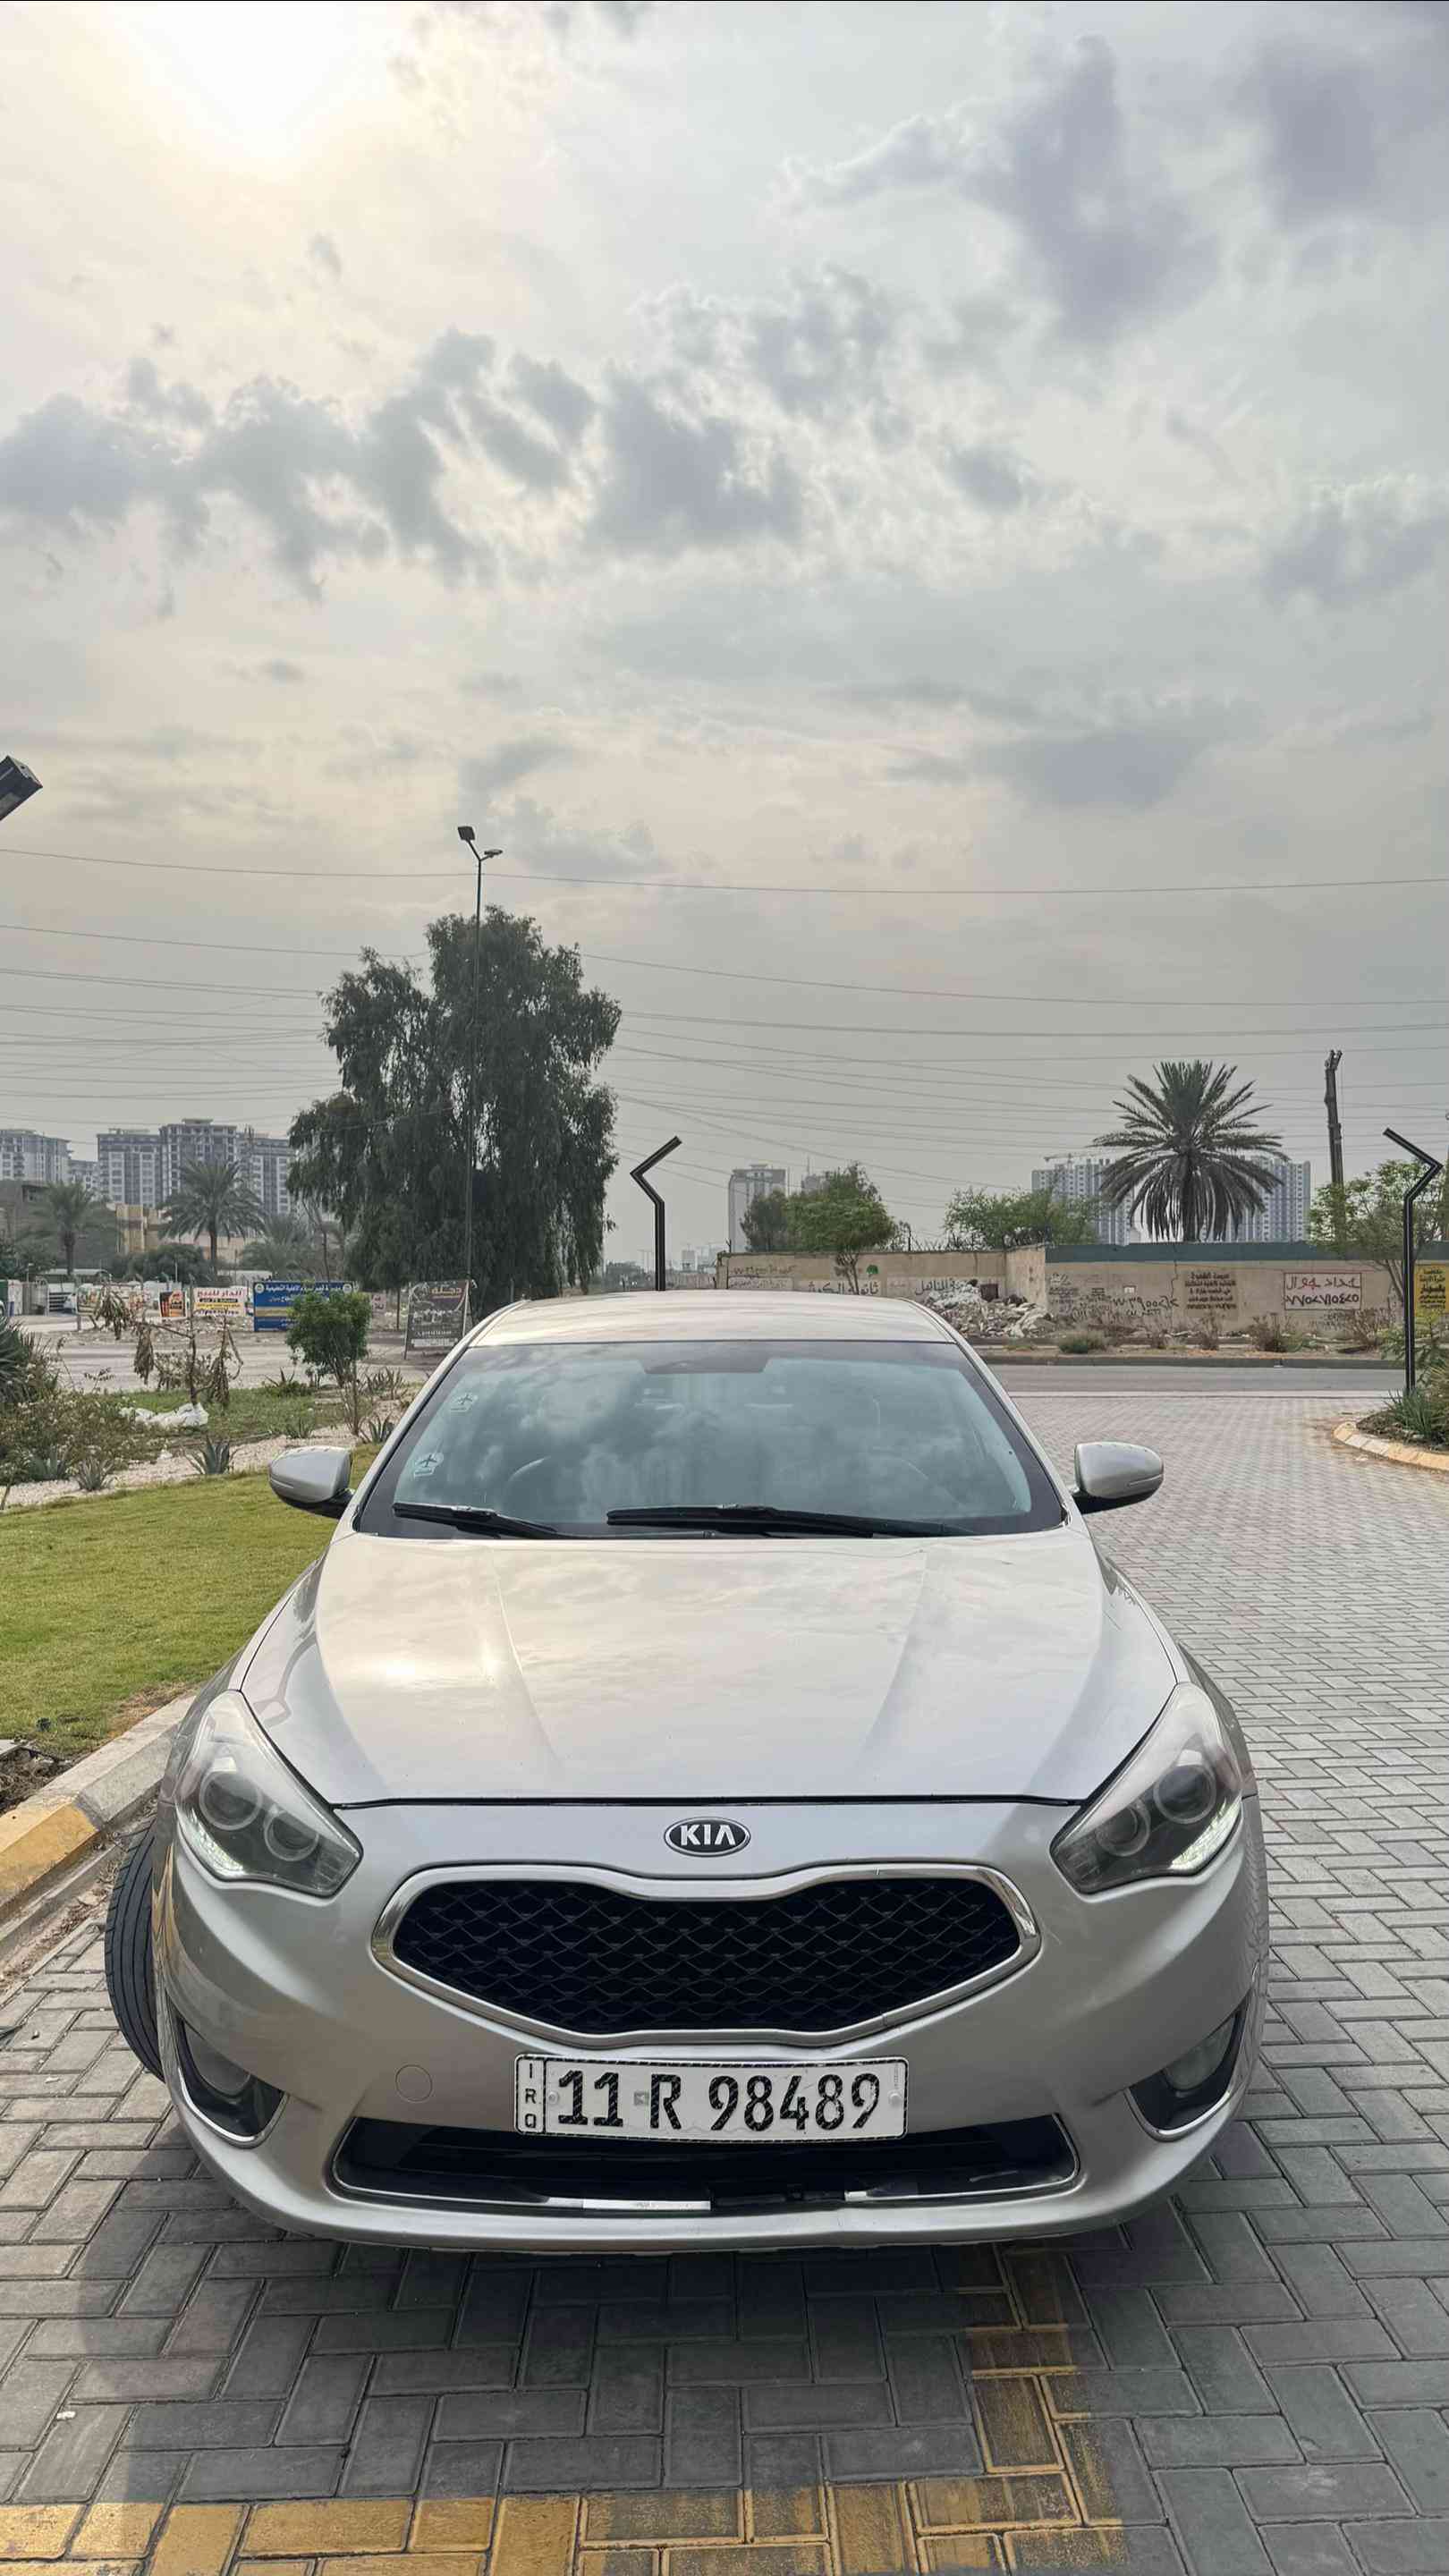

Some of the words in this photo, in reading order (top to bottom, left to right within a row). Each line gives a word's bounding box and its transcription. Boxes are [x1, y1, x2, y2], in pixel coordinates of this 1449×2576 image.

[680, 1824, 736, 1846] KIA
[558, 2070, 623, 2127] 11
[650, 2073, 682, 2131] R
[708, 2072, 880, 2132] 98489
